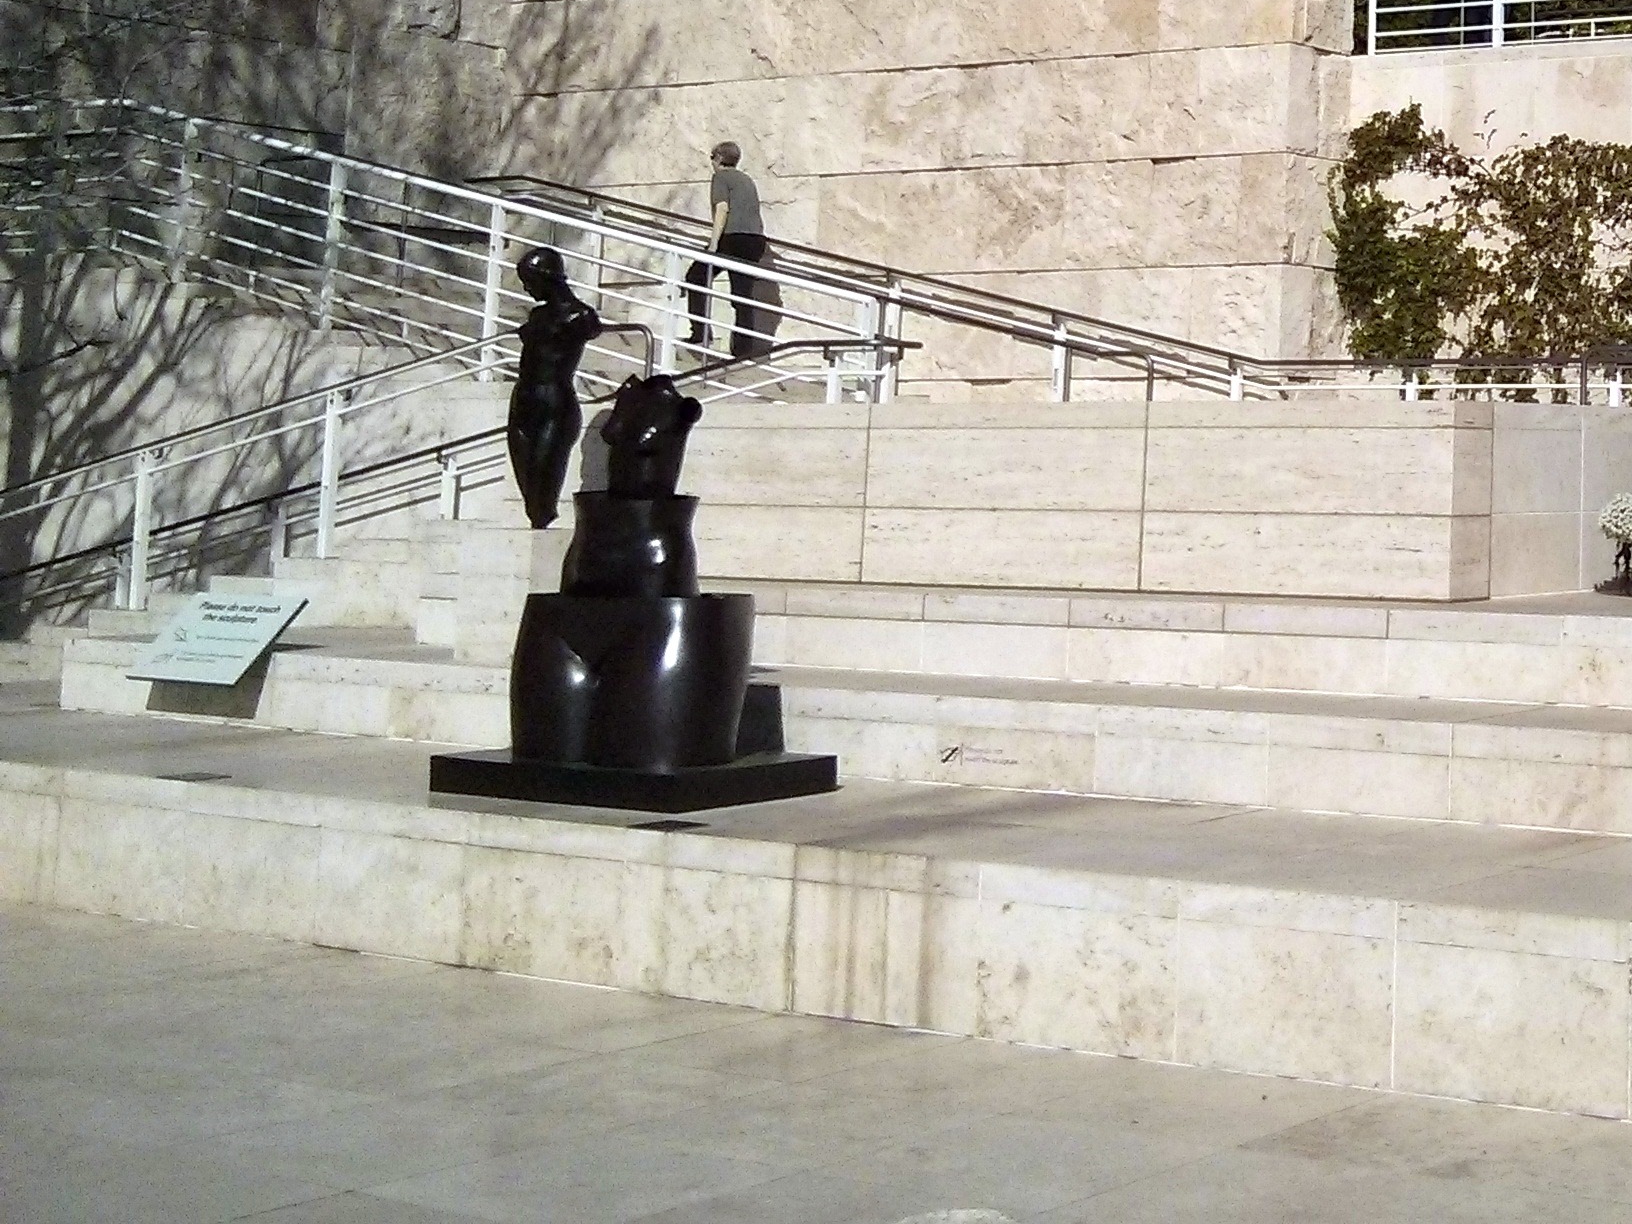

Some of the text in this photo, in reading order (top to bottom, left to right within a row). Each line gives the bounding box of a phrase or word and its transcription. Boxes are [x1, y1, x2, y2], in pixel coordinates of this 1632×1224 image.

[199, 601, 227, 611] Please
[227, 602, 239, 612] do
[256, 604, 281, 614] touch
[202, 613, 218, 621] the
